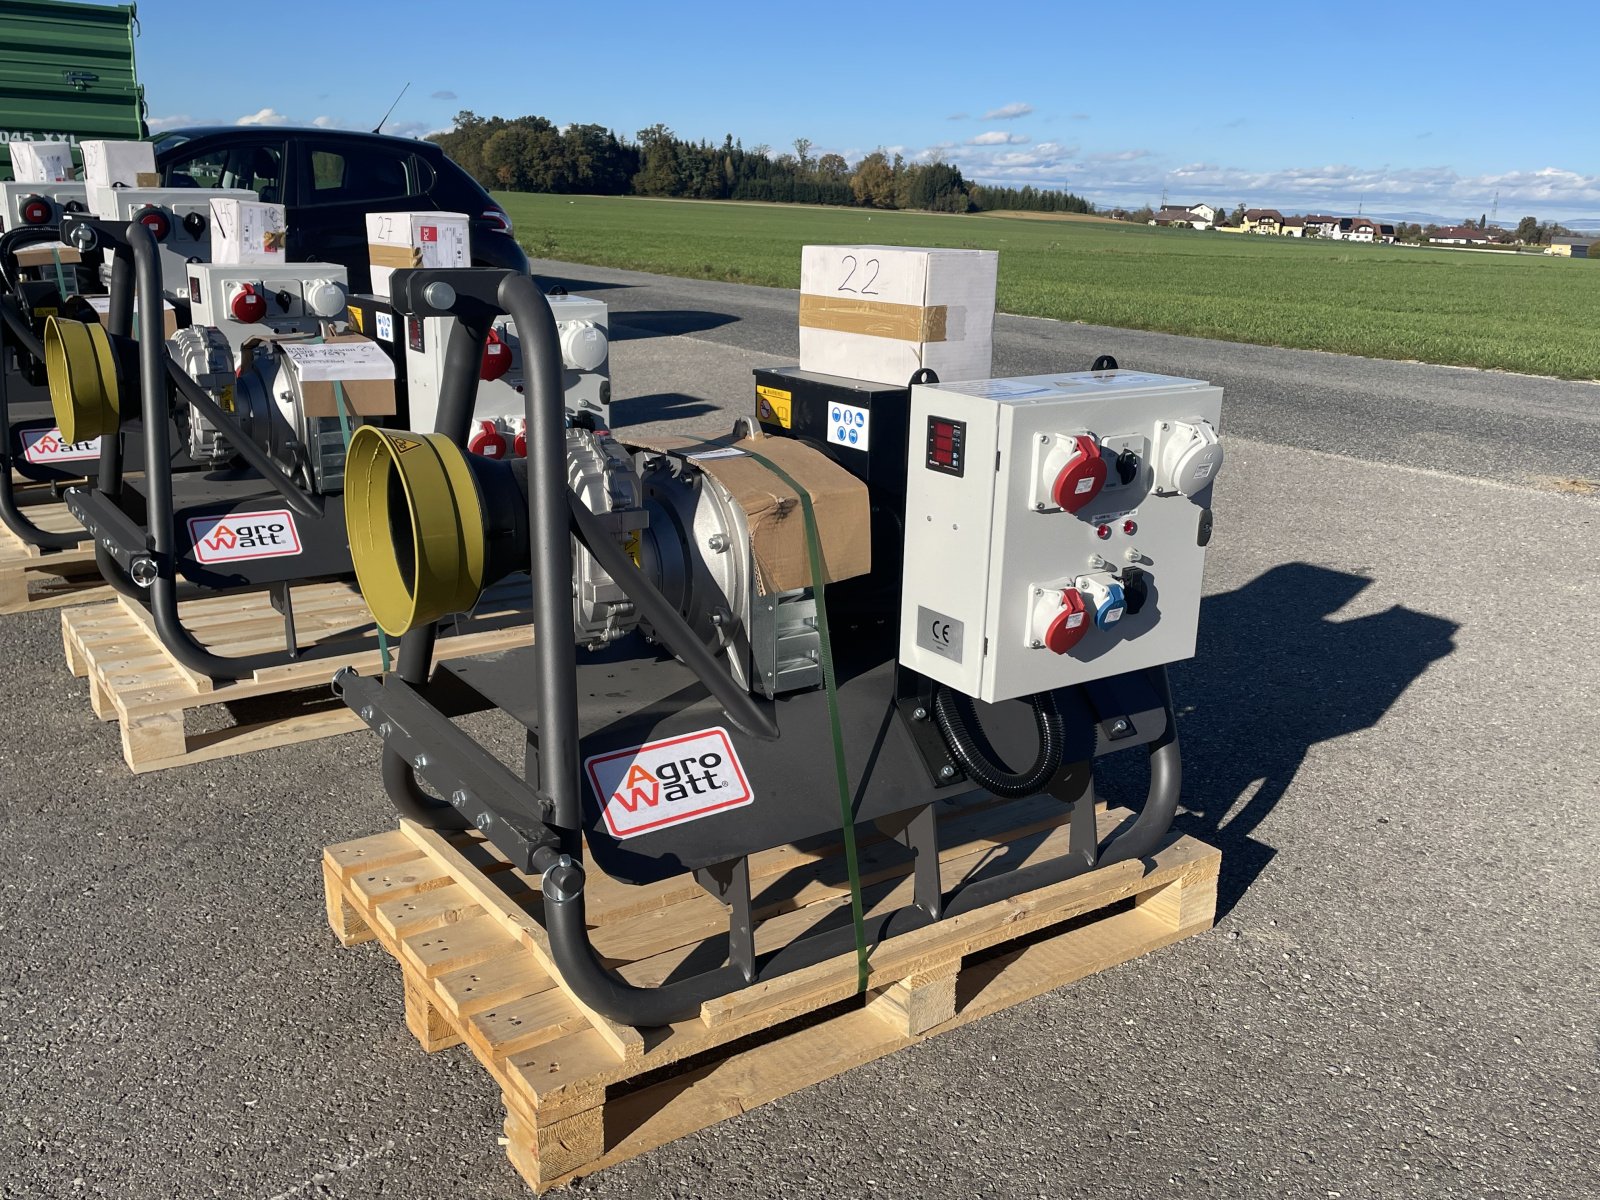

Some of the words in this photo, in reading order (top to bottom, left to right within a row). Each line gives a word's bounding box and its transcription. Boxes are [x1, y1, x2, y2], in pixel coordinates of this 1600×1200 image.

[43, 132, 80, 148] XXL
[377, 215, 393, 241] 27
[837, 255, 880, 295] 22
[213, 523, 284, 538] Agro
[932, 620, 950, 644] CE
[626, 752, 722, 790] Agro
